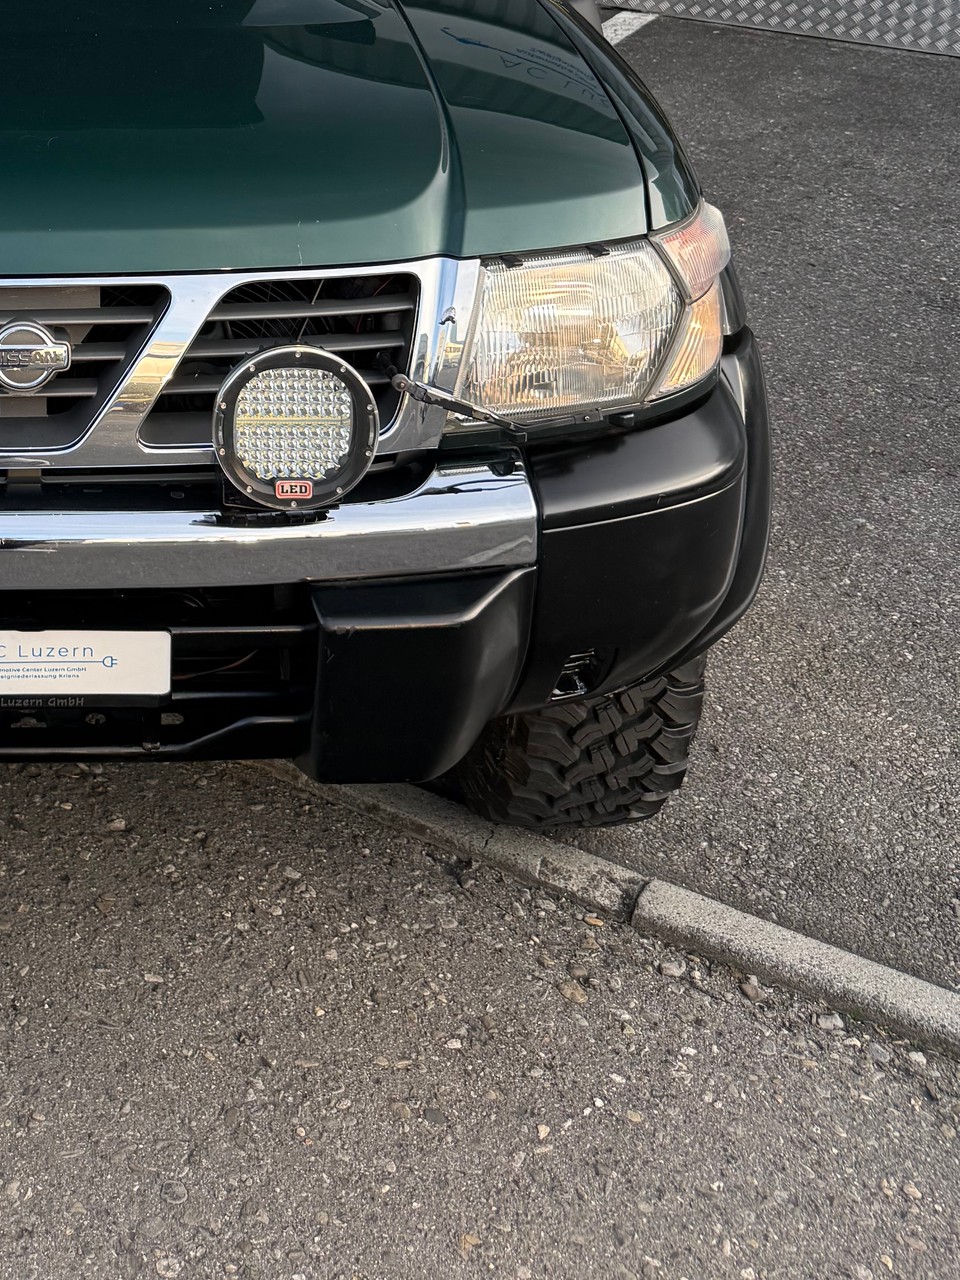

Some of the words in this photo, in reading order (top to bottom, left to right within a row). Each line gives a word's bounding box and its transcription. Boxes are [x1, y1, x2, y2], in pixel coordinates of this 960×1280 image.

[280, 484, 308, 495] LED
[18, 644, 94, 658] Luzern
[0, 697, 43, 707] Luzern
[47, 696, 85, 707] GmbH
